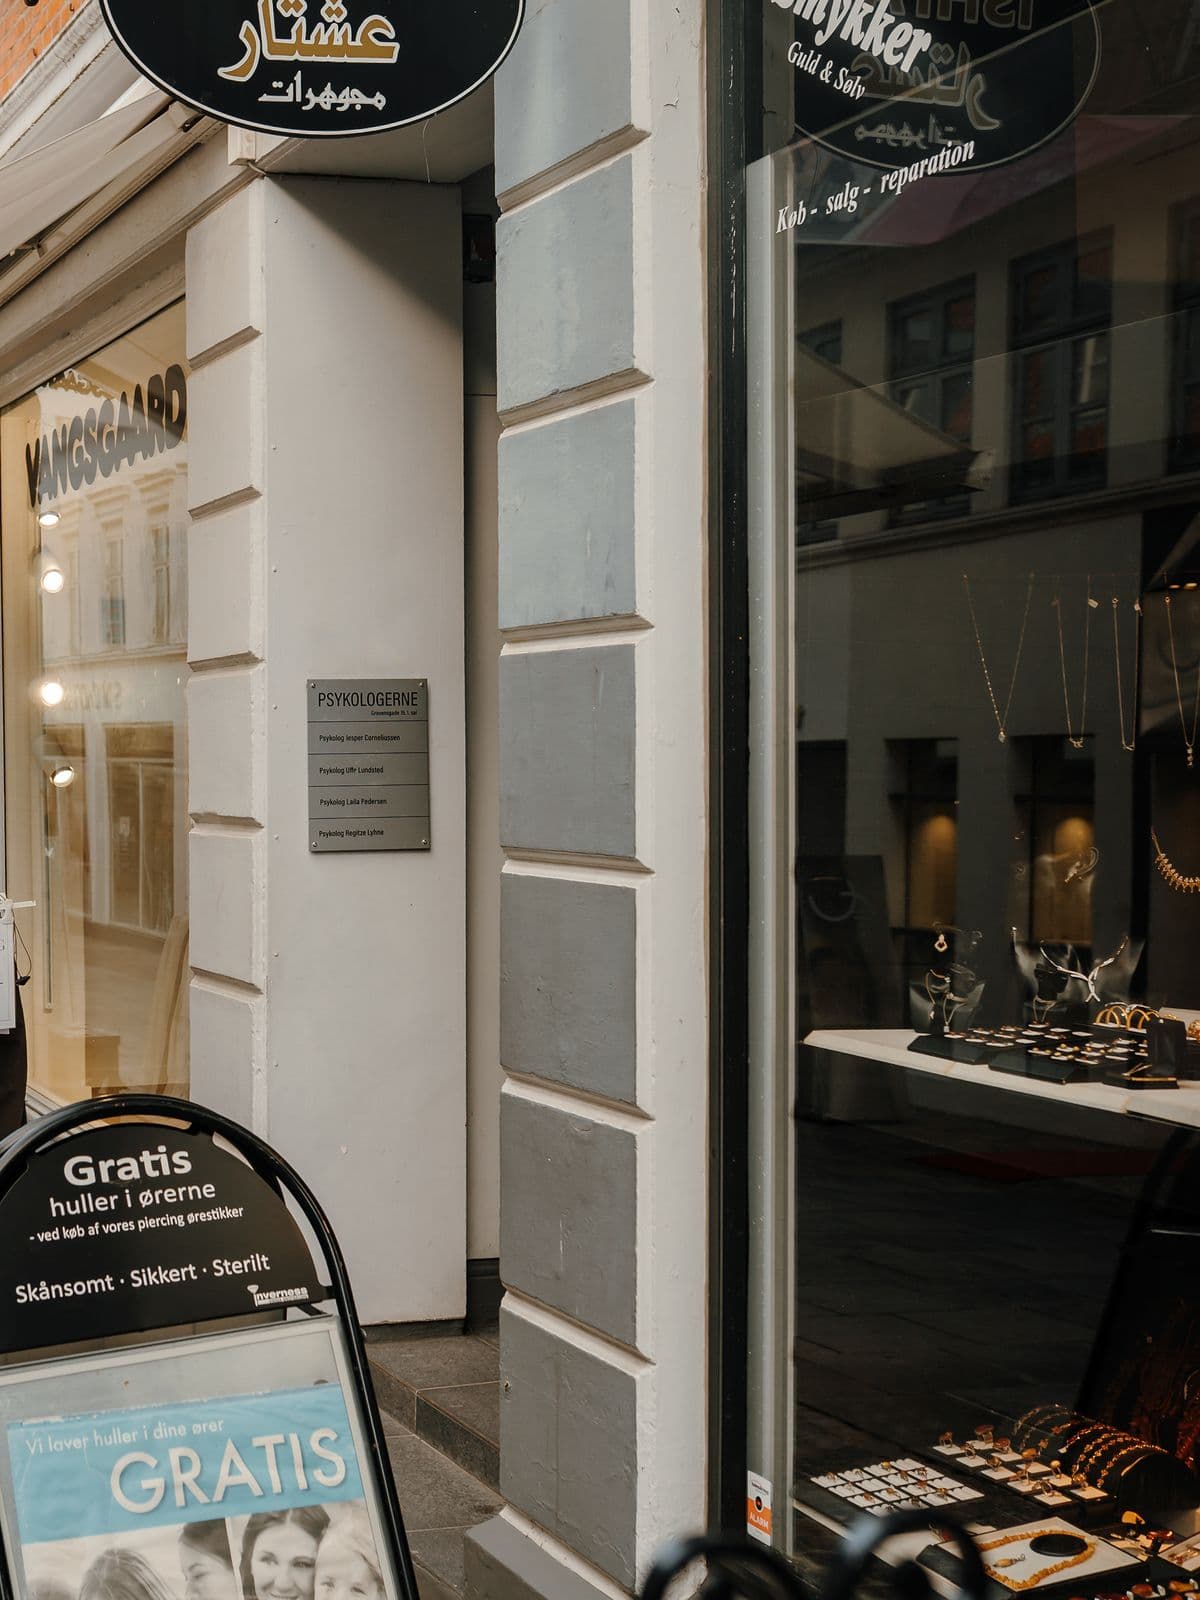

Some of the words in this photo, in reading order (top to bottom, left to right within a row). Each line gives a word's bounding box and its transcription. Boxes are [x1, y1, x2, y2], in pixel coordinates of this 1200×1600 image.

[770, 0, 932, 73] mykker
[258, 70, 387, 112] مجوهرات
[788, 41, 822, 76] Guld
[819, 60, 834, 84] &
[833, 67, 867, 100] Sølv
[776, 201, 807, 234] Køb
[825, 182, 860, 213] salg
[880, 140, 976, 195] reparation
[26, 363, 187, 508] VANGSGAARD
[318, 692, 418, 707] PSYKOLOGERNE
[319, 767, 345, 775] Psykolog
[318, 830, 345, 838] Psykolog
[345, 829, 366, 837] Regitze
[367, 829, 384, 837] Lyhne
[63, 1145, 192, 1187] Gratis
[49, 1193, 119, 1218] huller
[124, 1189, 132, 1208] i
[138, 1183, 216, 1208] ørerne
[36, 1228, 60, 1243] ved
[62, 1224, 85, 1239] køb
[88, 1222, 100, 1237] af
[101, 1219, 135, 1235] vores
[137, 1212, 185, 1232] piercing
[187, 1206, 244, 1225] ørestikker
[15, 1274, 115, 1304] Skånsomt
[129, 1263, 198, 1288] Sikkert
[211, 1253, 271, 1277] Sterilt
[25, 1439, 43, 1455] Vi
[48, 1436, 89, 1453] laver
[93, 1427, 139, 1447] huller
[143, 1425, 149, 1441] i
[153, 1421, 188, 1440] dine
[191, 1418, 225, 1435] ører
[110, 1428, 347, 1515] GRATIS
[749, 1511, 769, 1530] ALARM
